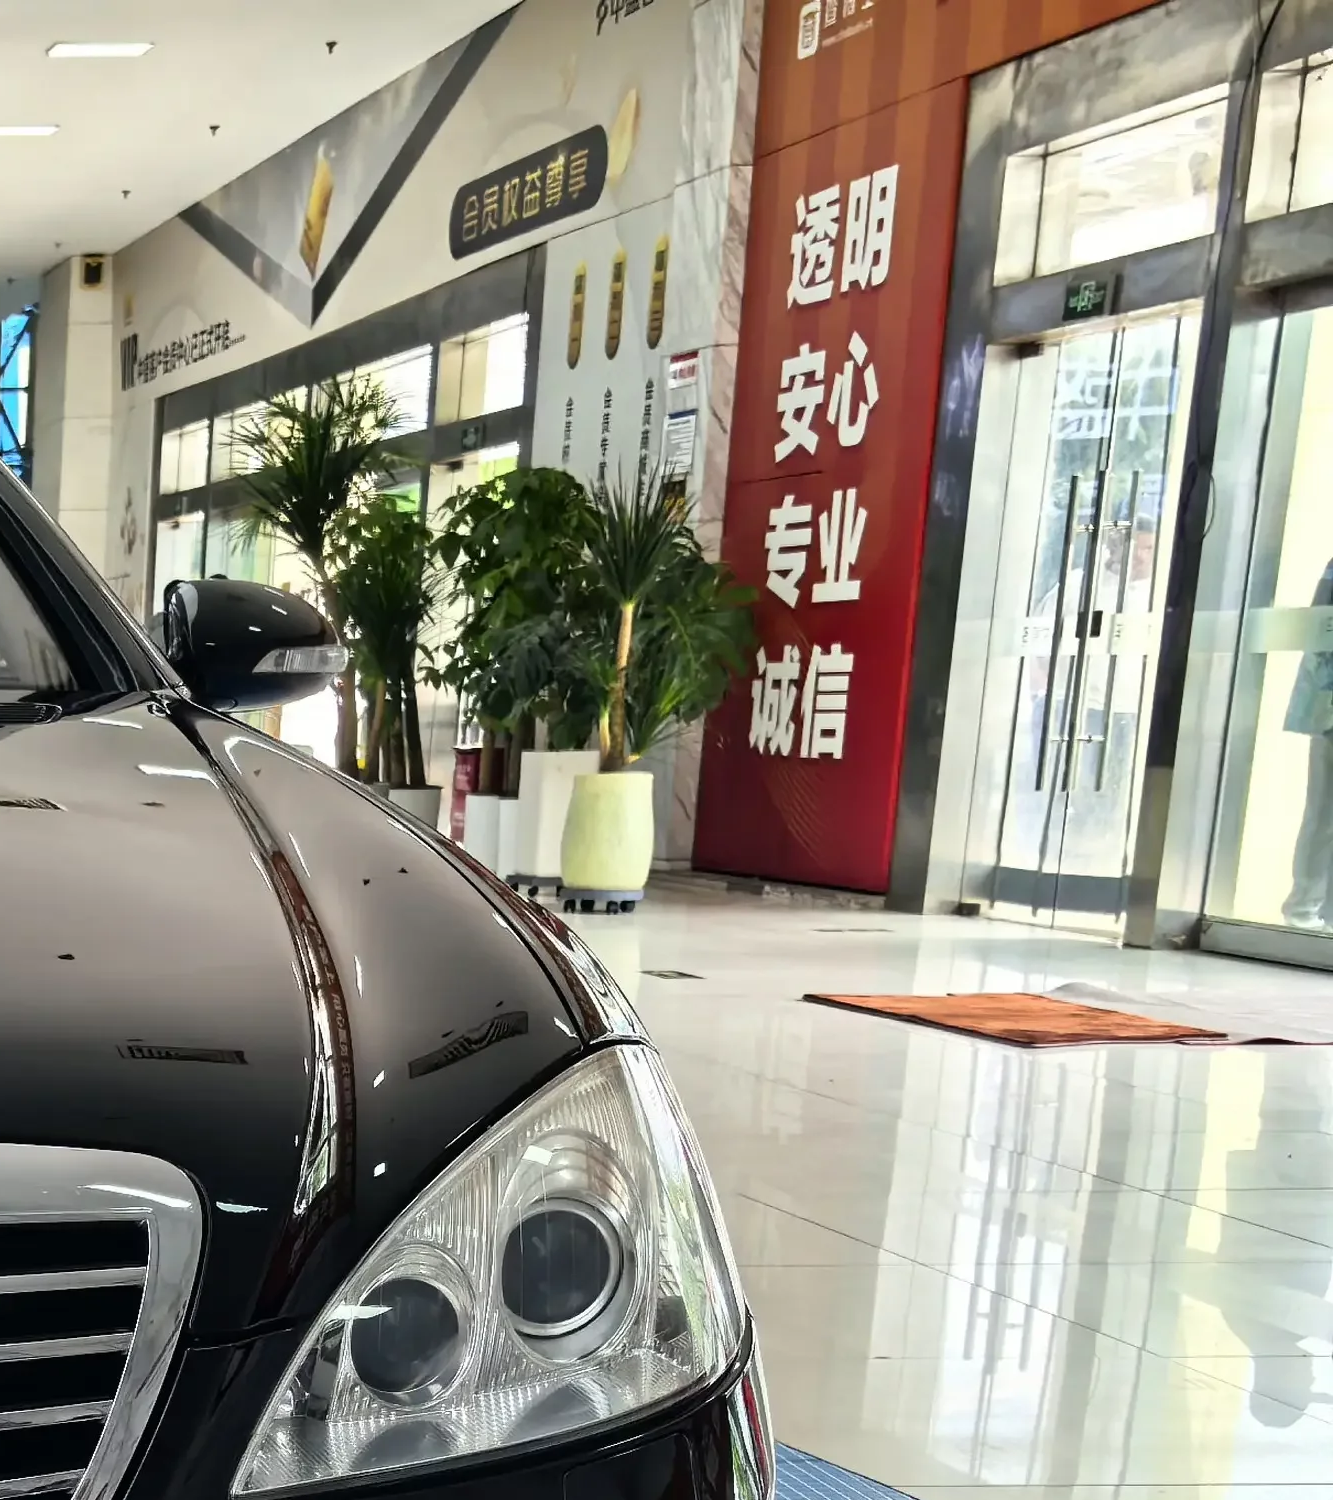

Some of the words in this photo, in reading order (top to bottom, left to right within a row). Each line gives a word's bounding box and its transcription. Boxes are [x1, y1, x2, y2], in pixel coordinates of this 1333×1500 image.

[462, 148, 589, 243] 会员权益尊享
[787, 163, 900, 310] 透明
[774, 330, 880, 464] 安心
[764, 487, 868, 609] 专业
[749, 643, 855, 760] 诚信
